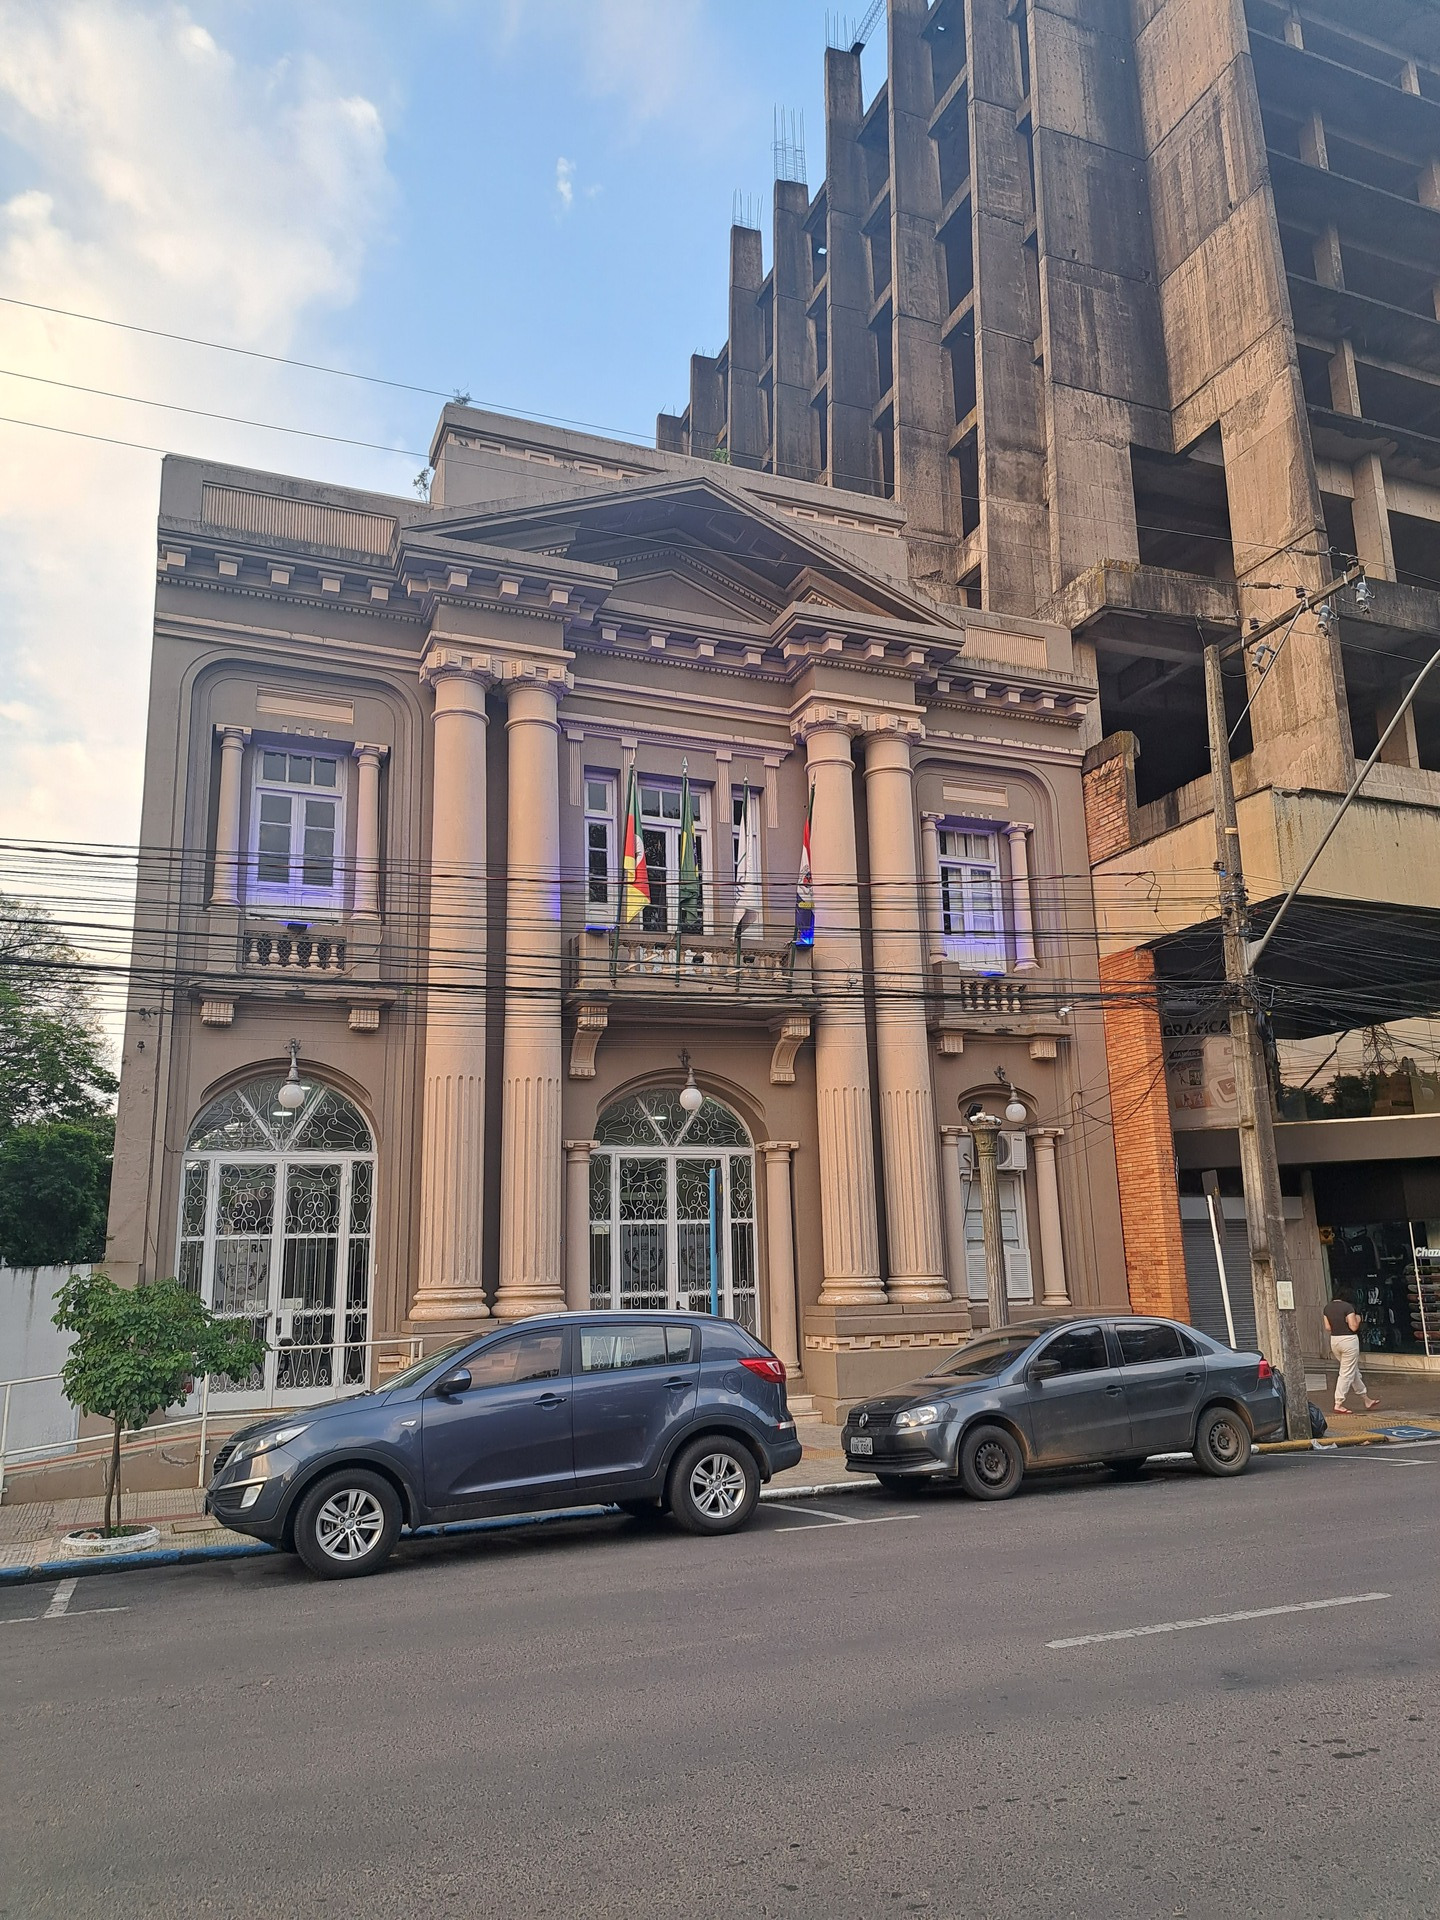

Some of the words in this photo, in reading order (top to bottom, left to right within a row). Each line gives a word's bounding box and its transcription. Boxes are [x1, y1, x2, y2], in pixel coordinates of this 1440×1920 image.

[1163, 1019, 1230, 1036] GRÁFICA
[684, 1225, 711, 1236] CÂMAR
[1416, 1246, 1440, 1257] Chaz
